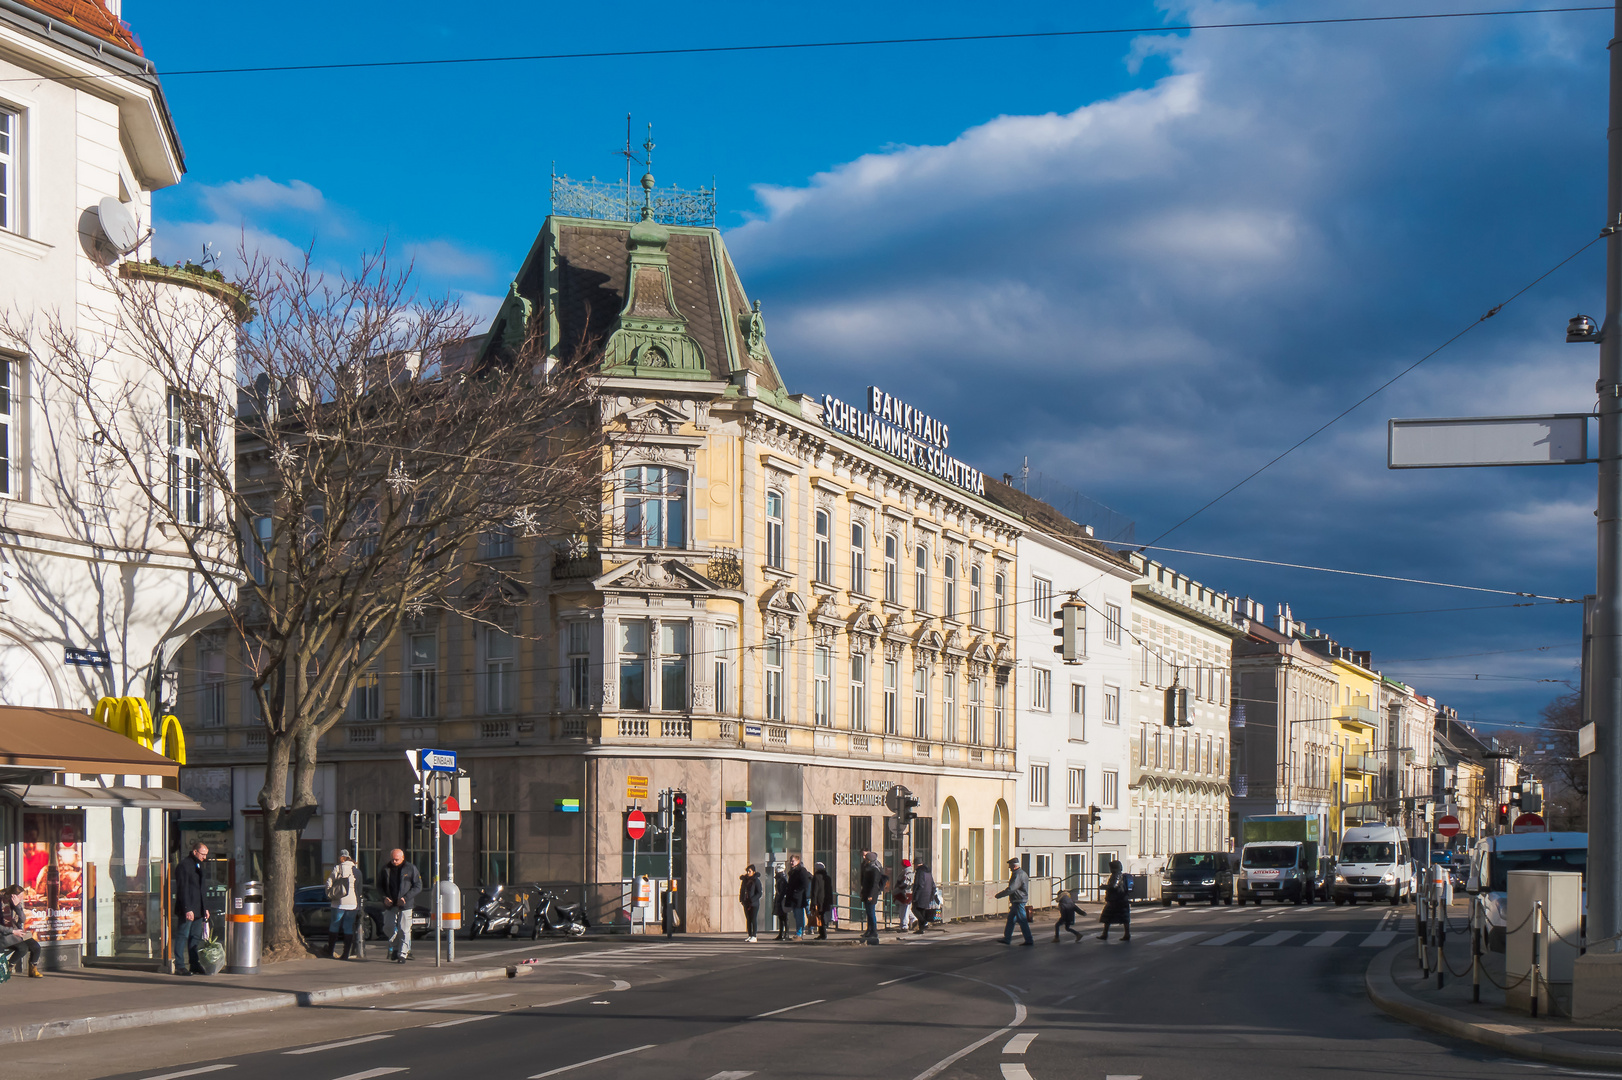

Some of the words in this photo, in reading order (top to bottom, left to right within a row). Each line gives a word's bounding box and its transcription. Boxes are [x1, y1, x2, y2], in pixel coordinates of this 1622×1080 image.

[870, 386, 949, 449] BANKHAUS
[824, 394, 916, 466] SCHELHAMMER
[918, 447, 926, 470] &
[928, 446, 985, 496] SCHATTERA
[433, 756, 454, 766] EINBAHN
[834, 793, 882, 806] SCHELHAMMER
[31, 907, 46, 920] Sag
[47, 906, 74, 918] Danke!
